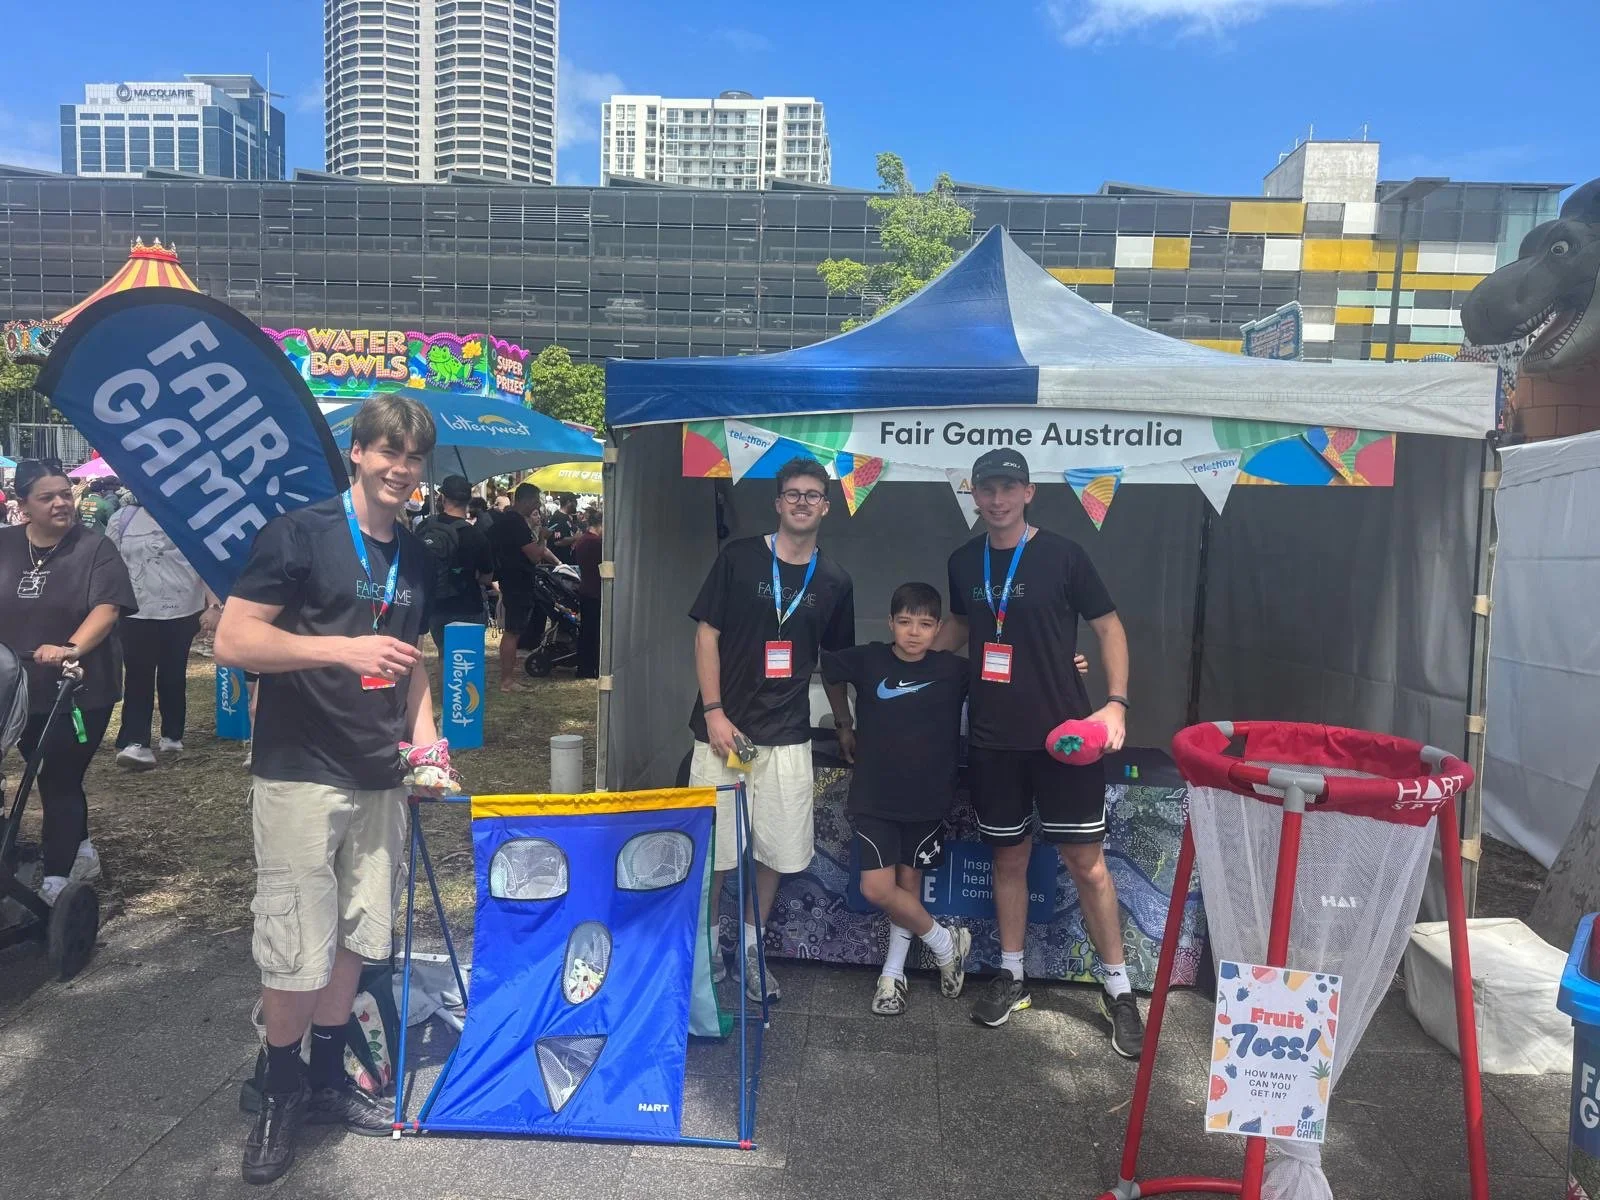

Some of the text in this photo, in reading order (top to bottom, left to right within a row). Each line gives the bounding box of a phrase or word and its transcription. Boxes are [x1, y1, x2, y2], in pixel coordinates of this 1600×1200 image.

[134, 89, 195, 98] MACQUARIE
[307, 327, 408, 355] WATER
[309, 352, 409, 380] BOWLS
[496, 355, 523, 376] SUPER
[495, 374, 524, 396] PRIZES
[147, 320, 289, 486] FAIR
[440, 412, 531, 437] lotterywest
[880, 420, 1183, 447] Fair Game Australia
[93, 368, 268, 562] GAME
[218, 666, 237, 717] rywest
[447, 649, 477, 728] lotterywest
[1396, 774, 1465, 802] HART
[1250, 1007, 1305, 1030] Fruit
[1244, 1069, 1298, 1082] HOW MANY
[1248, 1079, 1292, 1091] CAN YOU
[1250, 1089, 1287, 1101] GET IN?
[638, 1102, 670, 1113] HART
[1296, 1128, 1323, 1140] GAME
[1297, 1119, 1317, 1131] FAIR
